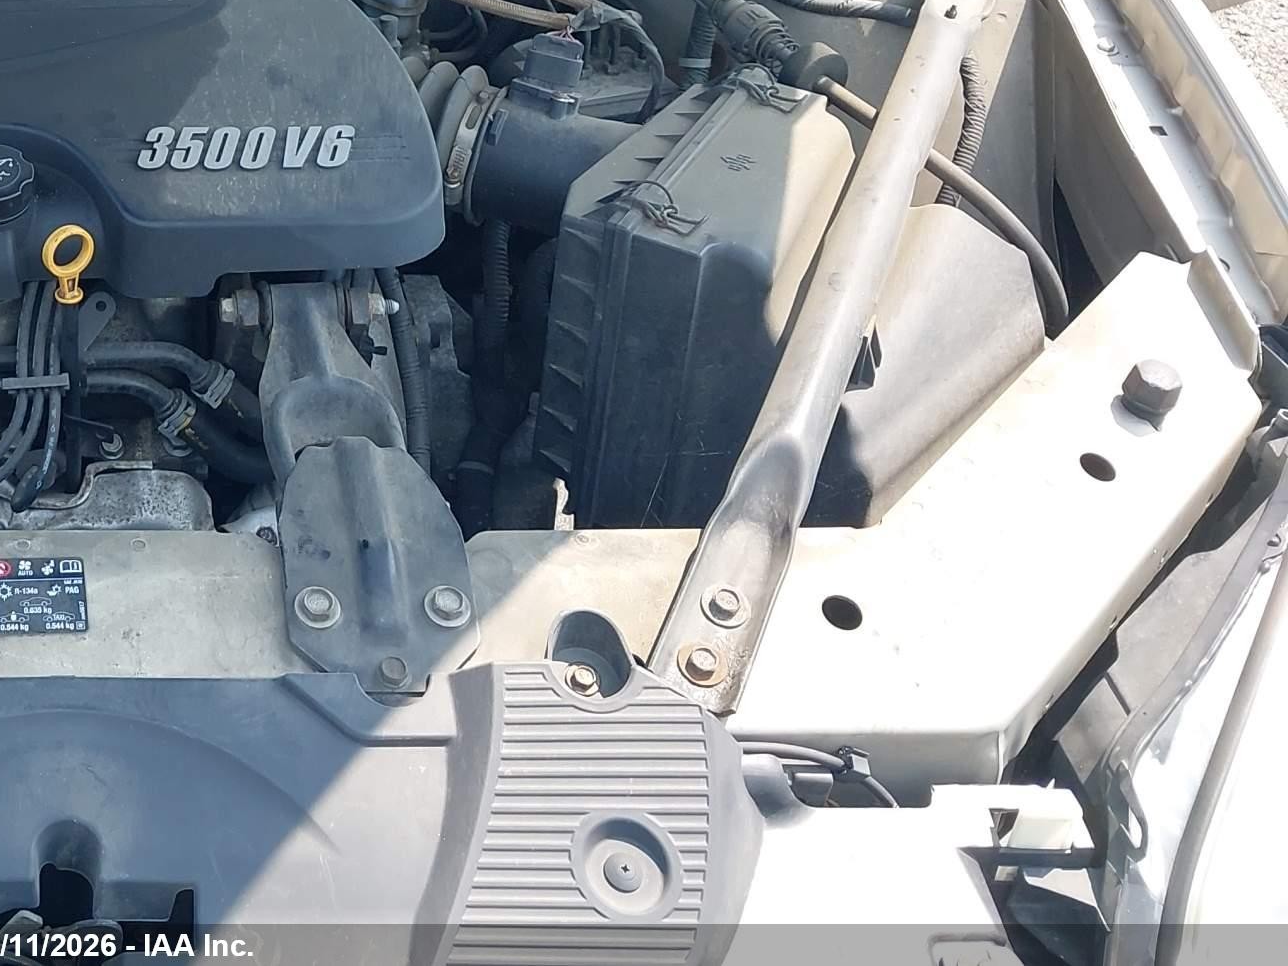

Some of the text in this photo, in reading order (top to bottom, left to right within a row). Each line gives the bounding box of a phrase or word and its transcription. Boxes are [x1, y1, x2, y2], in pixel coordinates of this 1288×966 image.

[137, 125, 355, 170] 3500 V6
[43, 606, 52, 614] kg
[20, 623, 29, 631] kg
[65, 621, 74, 630] kg
